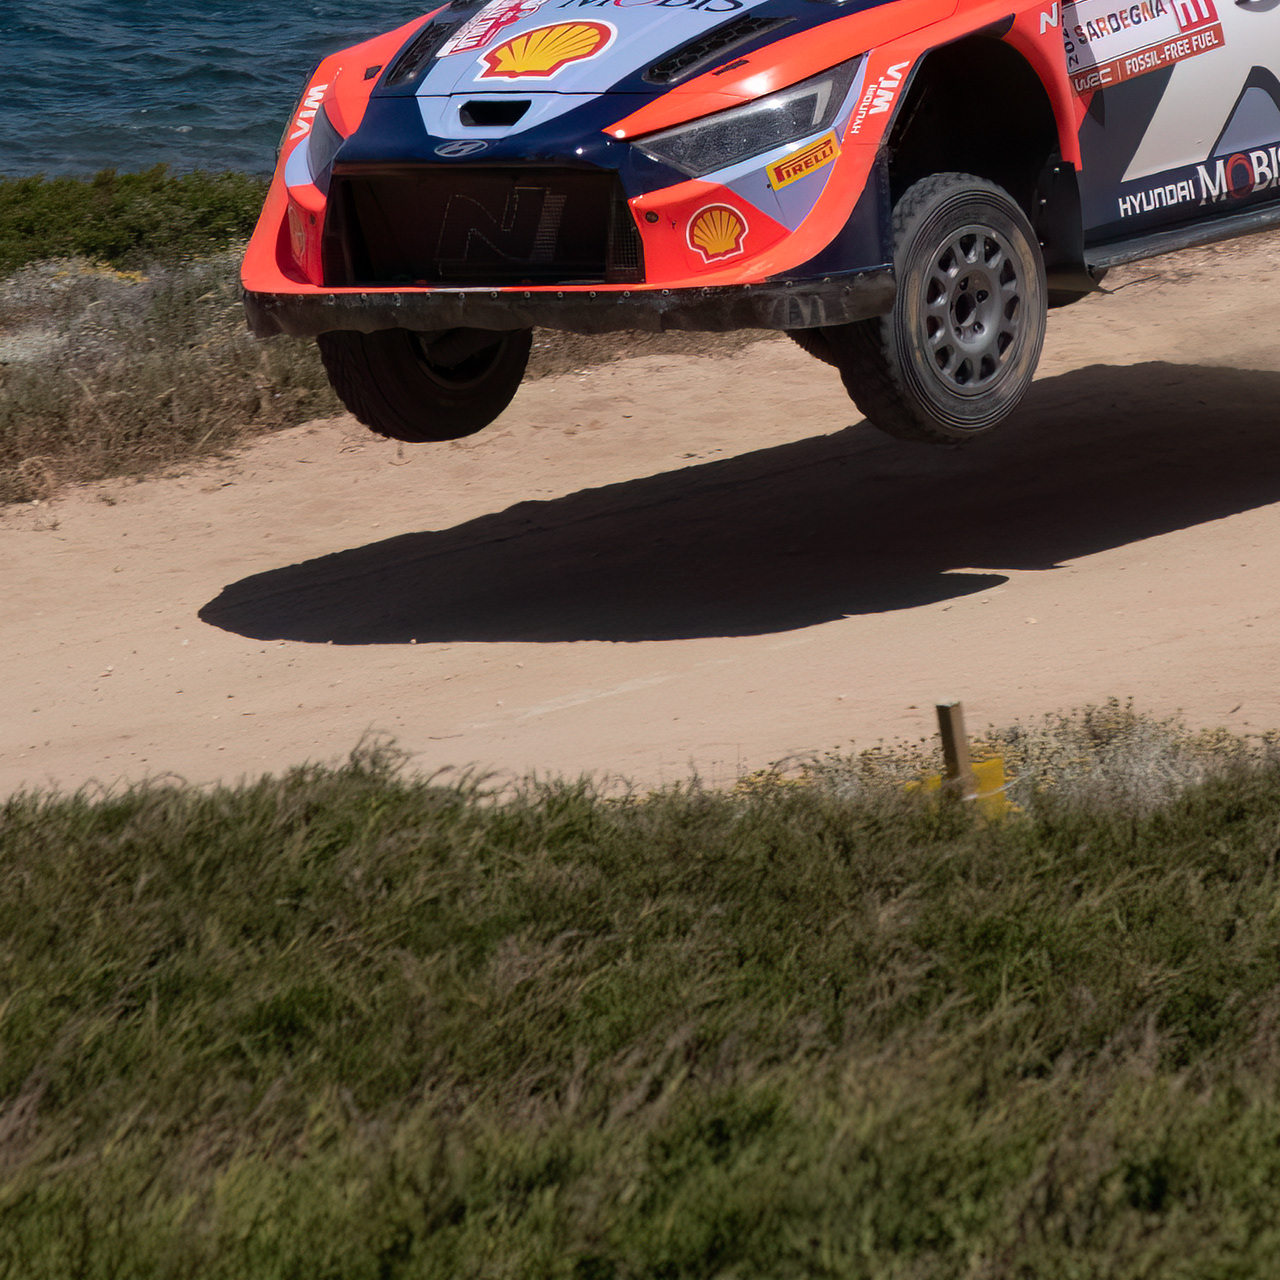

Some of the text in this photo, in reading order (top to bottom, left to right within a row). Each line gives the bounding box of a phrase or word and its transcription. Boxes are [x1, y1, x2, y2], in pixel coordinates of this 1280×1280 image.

[1040, 2, 1058, 35] N
[1074, 30, 1219, 92] WRC FOSSIL-FREE FUEL
[851, 84, 878, 134] HYUNDAI
[869, 61, 910, 115] WIA
[773, 138, 834, 183] PIRELLI
[1118, 180, 1195, 218] HYUNDAI
